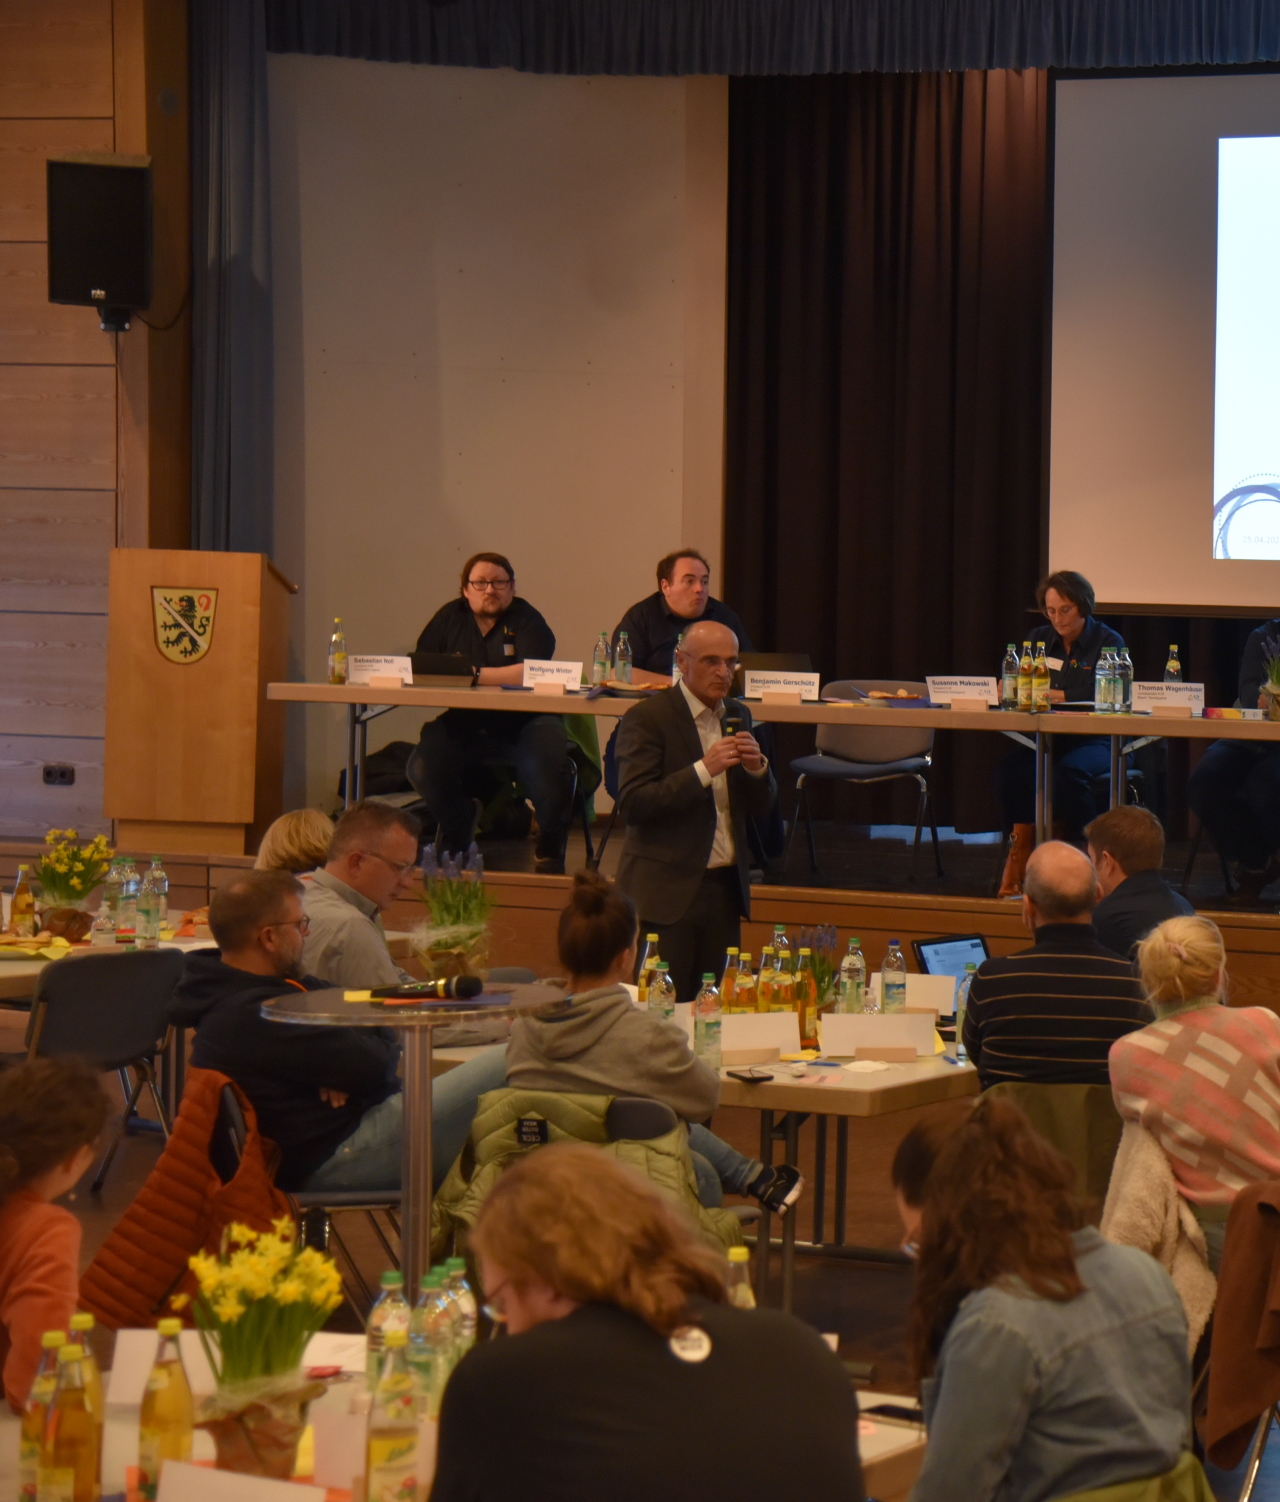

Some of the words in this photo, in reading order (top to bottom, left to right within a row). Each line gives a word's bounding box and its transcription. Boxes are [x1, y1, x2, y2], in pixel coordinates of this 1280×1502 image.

[529, 666, 555, 674] Wolfgang
[750, 677, 781, 686] Benjamin
[782, 679, 815, 687] Gerschütz
